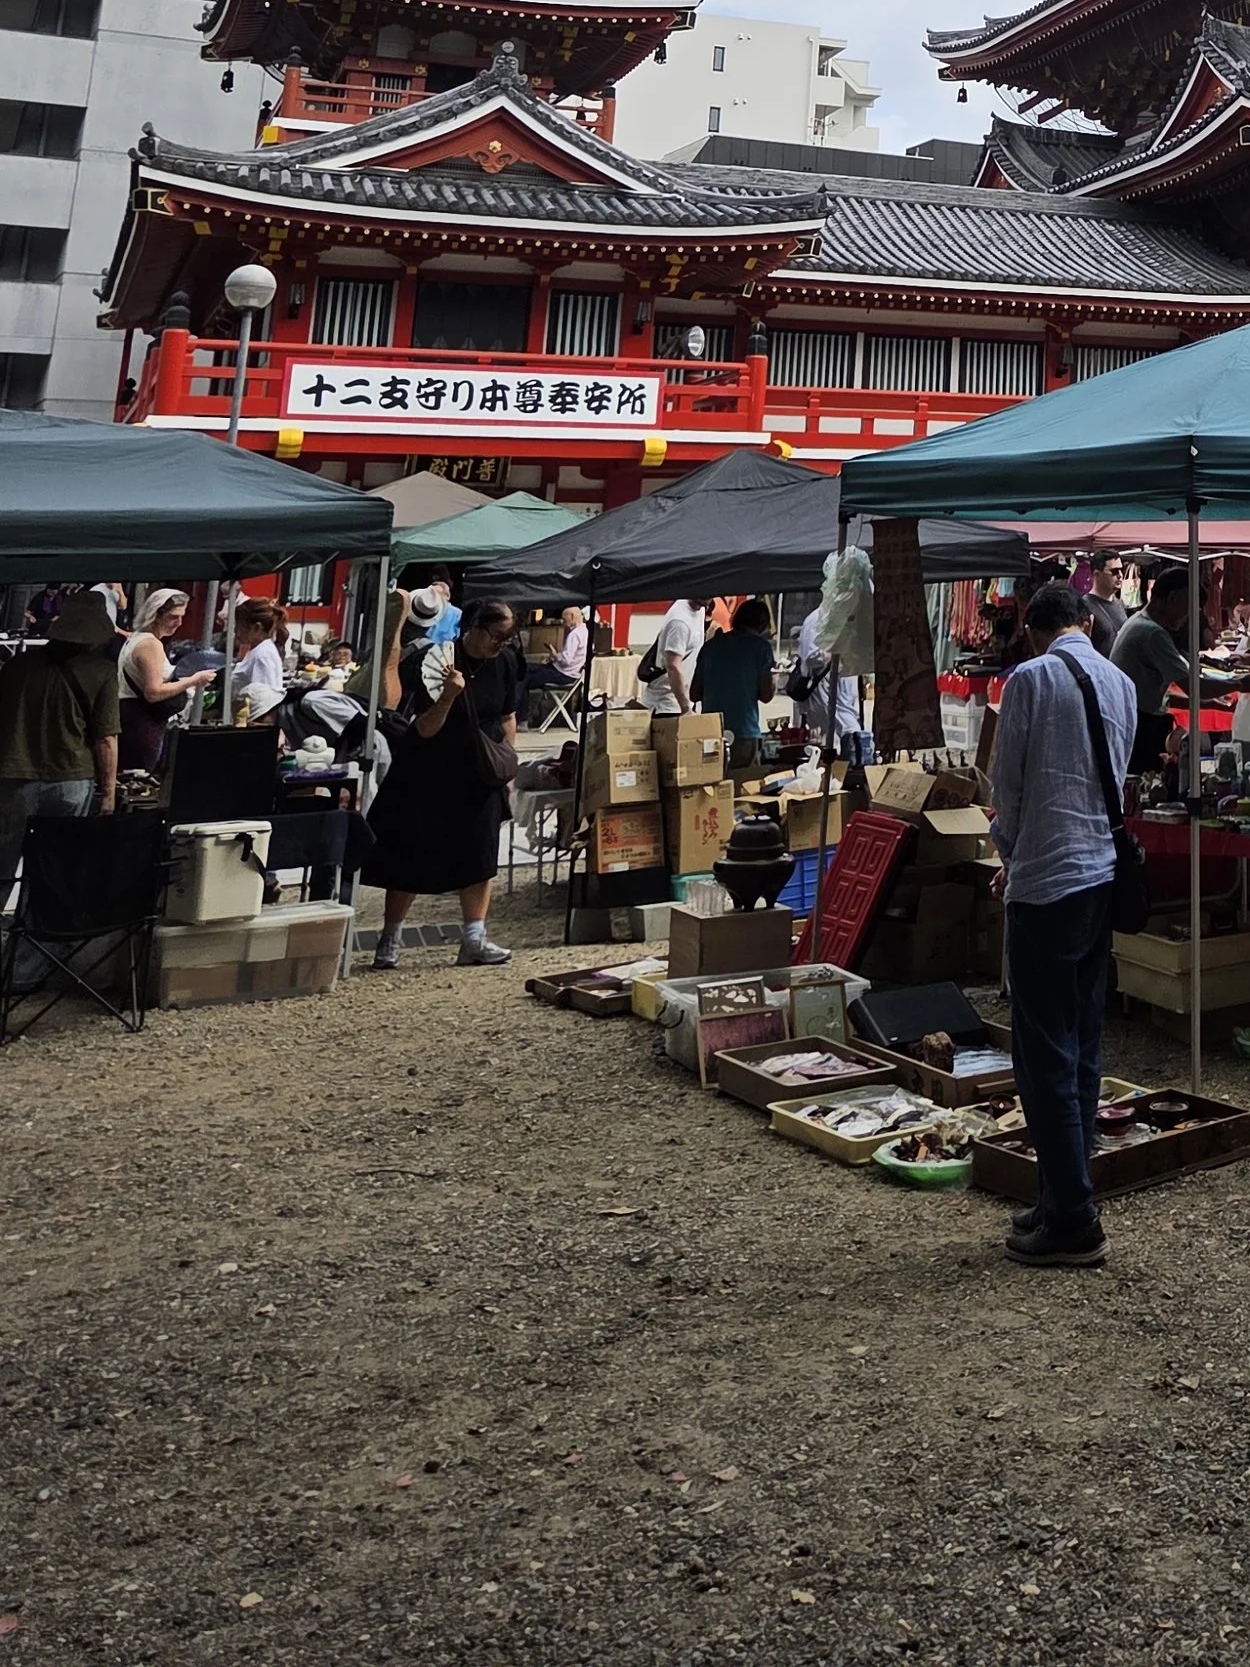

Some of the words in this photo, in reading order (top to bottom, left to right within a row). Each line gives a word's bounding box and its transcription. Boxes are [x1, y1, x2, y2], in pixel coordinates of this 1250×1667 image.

[302, 373, 647, 416] 十二支守り本尊奉安所
[427, 457, 497, 482] 普門殿
